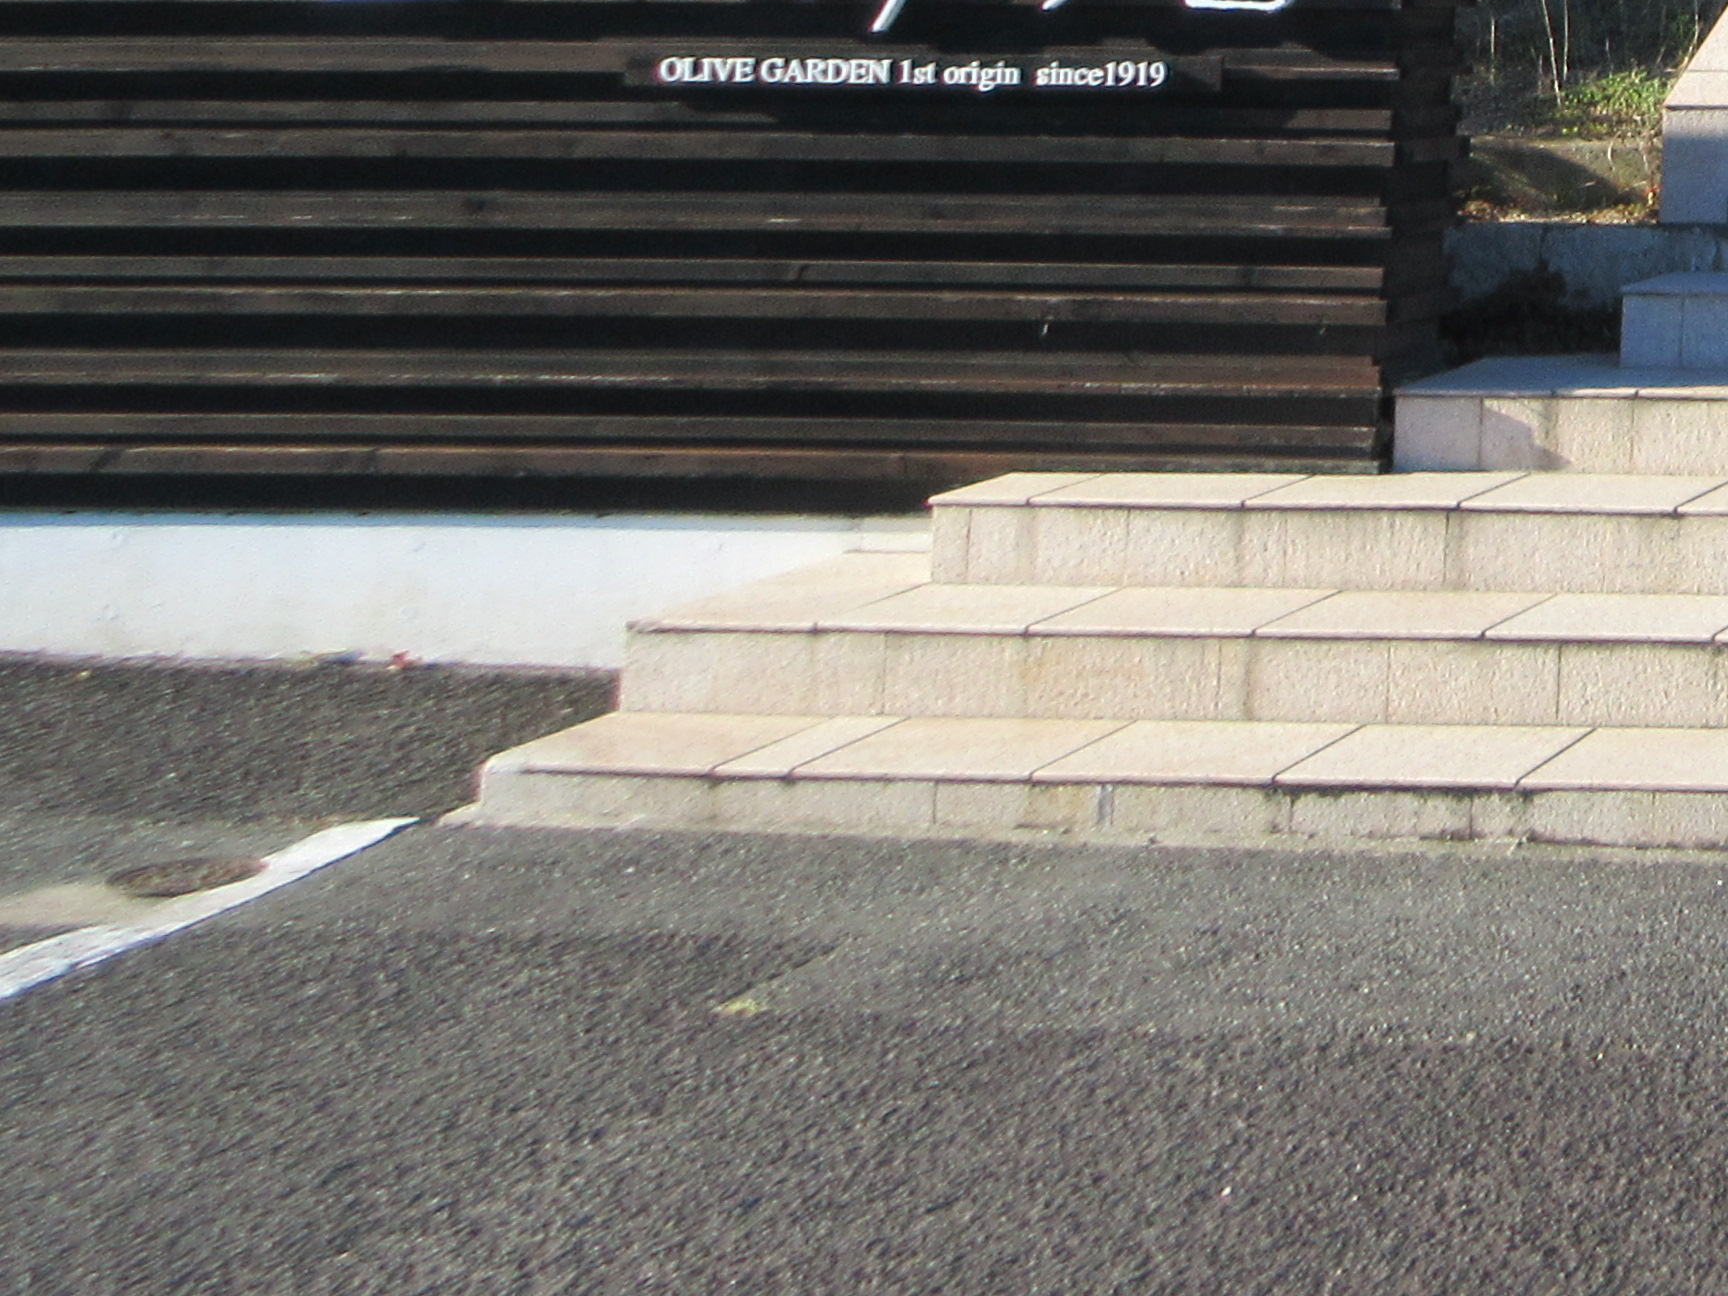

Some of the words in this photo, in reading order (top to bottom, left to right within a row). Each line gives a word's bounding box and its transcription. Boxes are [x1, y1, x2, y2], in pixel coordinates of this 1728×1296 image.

[658, 56, 756, 83] OLIVE
[760, 57, 893, 85] GARDEN
[899, 58, 938, 85] 1st
[943, 59, 1021, 93] origin
